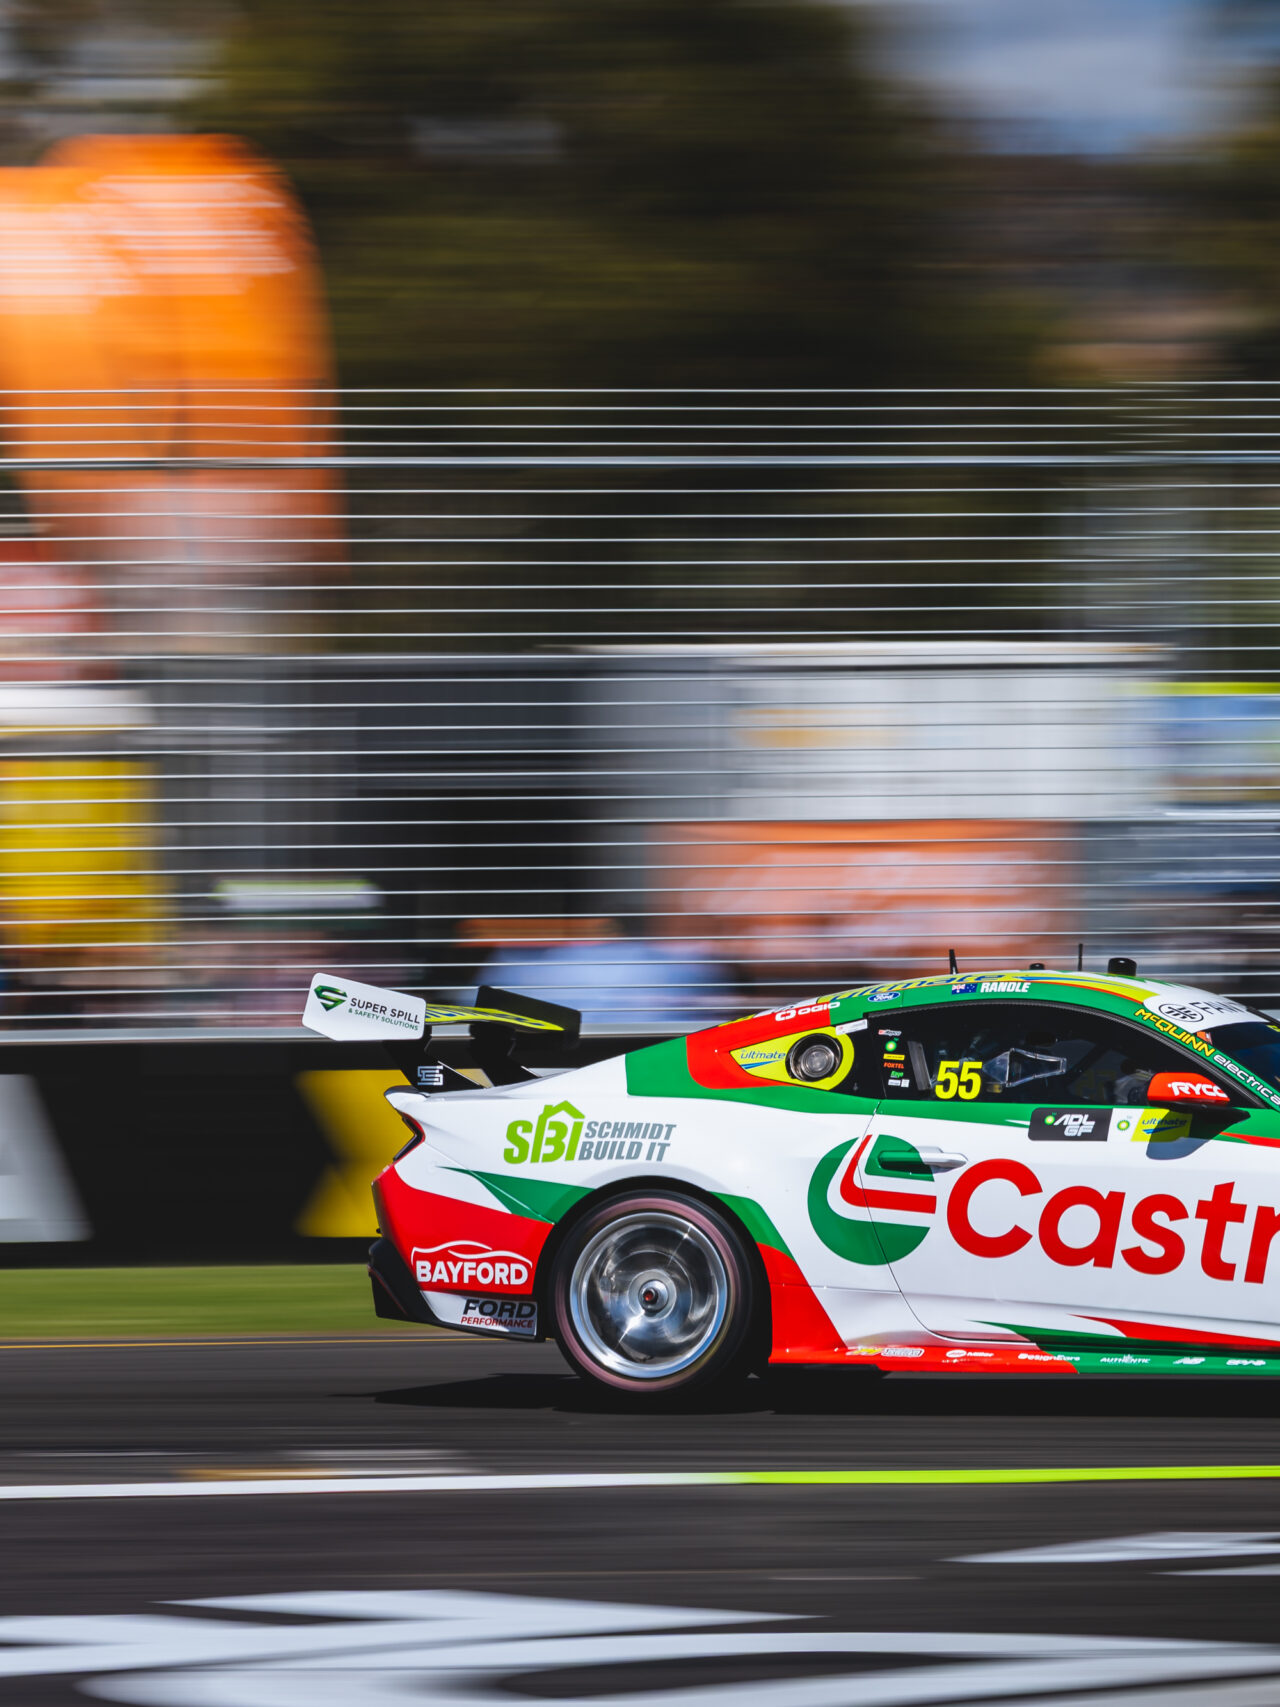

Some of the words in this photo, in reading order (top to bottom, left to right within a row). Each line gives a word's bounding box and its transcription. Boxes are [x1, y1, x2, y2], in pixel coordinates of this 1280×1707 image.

[980, 981, 1032, 993] RANDLE
[350, 998, 387, 1015] SUPER
[390, 1008, 420, 1024] SPILL
[354, 1009, 380, 1020] SAFETY
[381, 1016, 418, 1031] SOLUTIONS
[740, 1051, 786, 1059] ultimate
[935, 1060, 983, 1100] 55
[1053, 1114, 1096, 1126] ADL
[1142, 1117, 1188, 1126] ultimate
[584, 1121, 677, 1141] SCHMIDT
[578, 1141, 645, 1161] BUILD
[645, 1142, 671, 1162] IT
[416, 1259, 529, 1285] BAYFORD
[462, 1298, 537, 1318] FORD
[460, 1316, 533, 1329] PERFORMANCE
